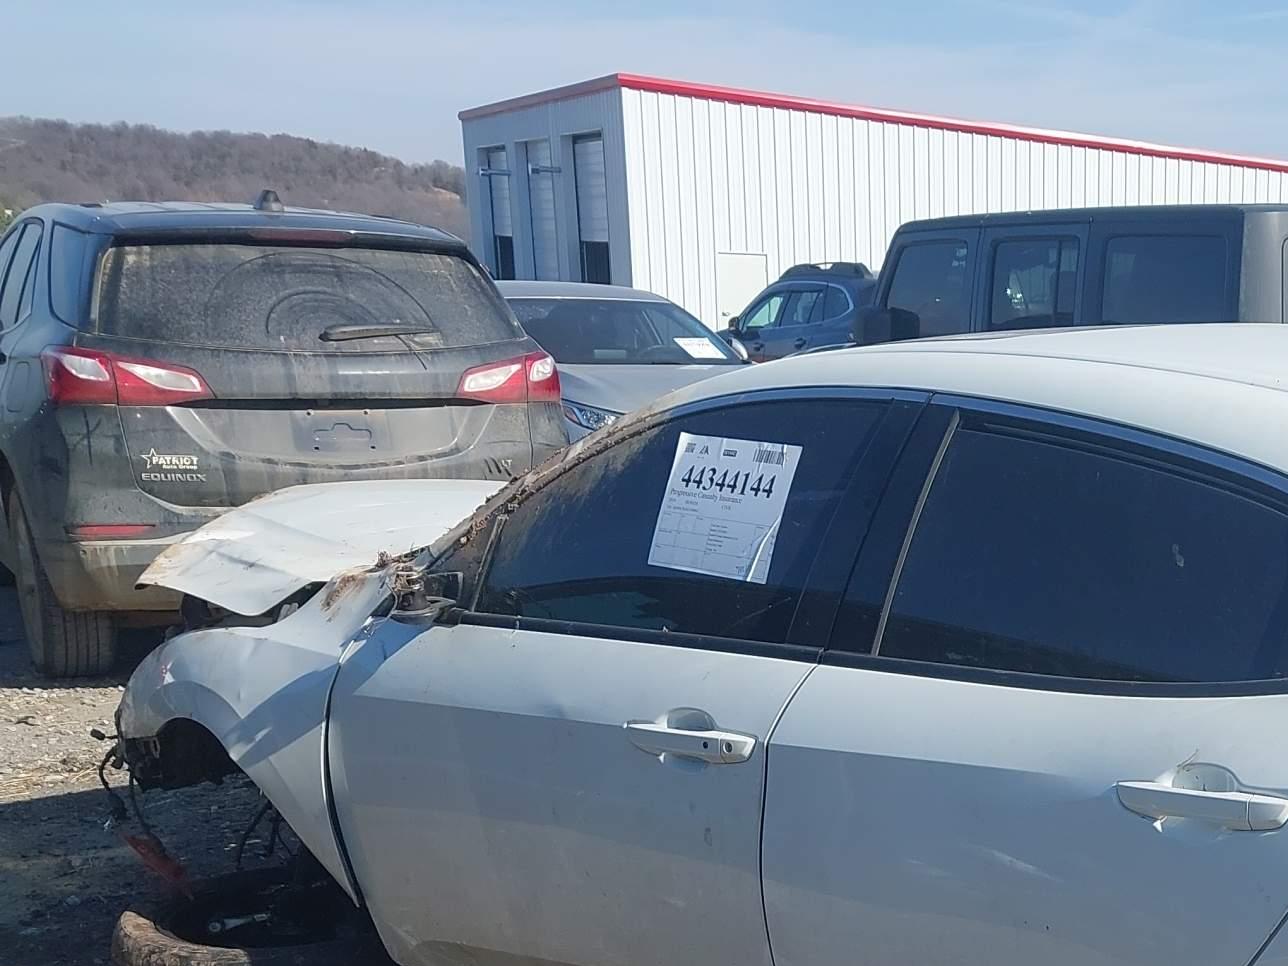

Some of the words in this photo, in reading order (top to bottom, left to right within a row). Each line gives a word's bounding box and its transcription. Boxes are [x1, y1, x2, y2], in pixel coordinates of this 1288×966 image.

[152, 456, 199, 465] PATRIOT
[501, 459, 513, 467] LT
[141, 472, 207, 482] EQUINOX
[681, 464, 776, 499] 44344144
